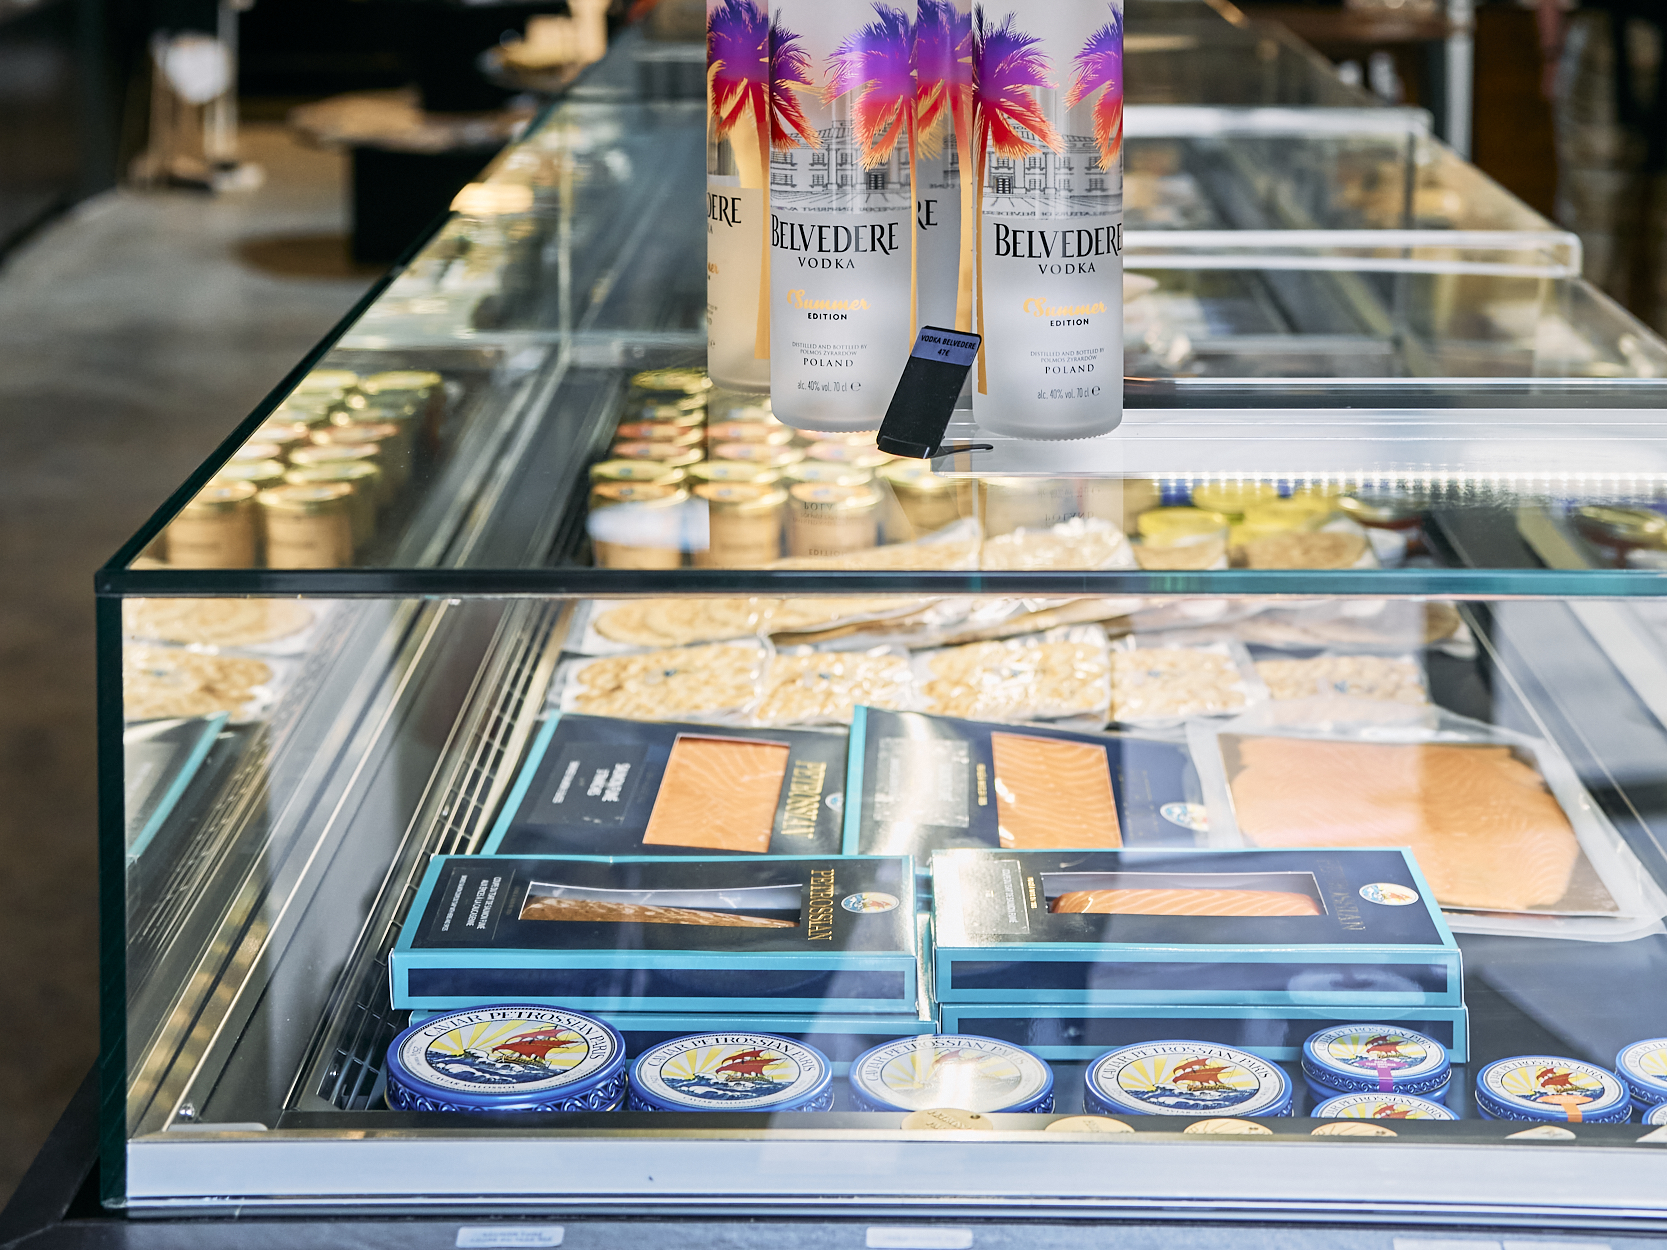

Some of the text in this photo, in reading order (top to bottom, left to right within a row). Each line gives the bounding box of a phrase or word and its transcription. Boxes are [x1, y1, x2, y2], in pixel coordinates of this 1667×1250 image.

[771, 213, 899, 255] BELVEDERE
[993, 222, 1122, 258] BELVEDERE
[797, 256, 855, 269] VODKA
[1038, 261, 1096, 275] VODKA
[786, 289, 872, 311] Summer
[1023, 297, 1107, 318] Summer
[807, 312, 848, 321] EDITION
[1050, 318, 1089, 327] EDITION
[791, 341, 817, 350] DISTILLED
[921, 334, 976, 350] VODKA BELVEDERE
[803, 357, 854, 367] POLAND
[1045, 363, 1095, 375] POLAND
[807, 380, 820, 391] 40%
[833, 381, 841, 392] 70
[1037, 390, 1048, 400] alc.
[1050, 389, 1064, 400] 40%
[1076, 387, 1083, 398] 70
[780, 760, 828, 839] PETROSSIAN
[1316, 859, 1366, 931] PEOSSIAN
[807, 868, 835, 941] PETROSSIAN
[423, 1010, 608, 1060] CAVIAR PETROSSIAN PARIS
[1335, 1026, 1406, 1039] PETROSSIAN
[648, 1036, 816, 1072] CAVIAR PETROSSIAN PARIS
[866, 1038, 1030, 1082] CAVIAR PETROSSIAN PARIS
[1102, 1044, 1273, 1080] CAVIAR PETROSSIAN PARIS
[1500, 1059, 1573, 1072] PETROSSIAN
[1339, 1094, 1413, 1107] PETROSSIAN
